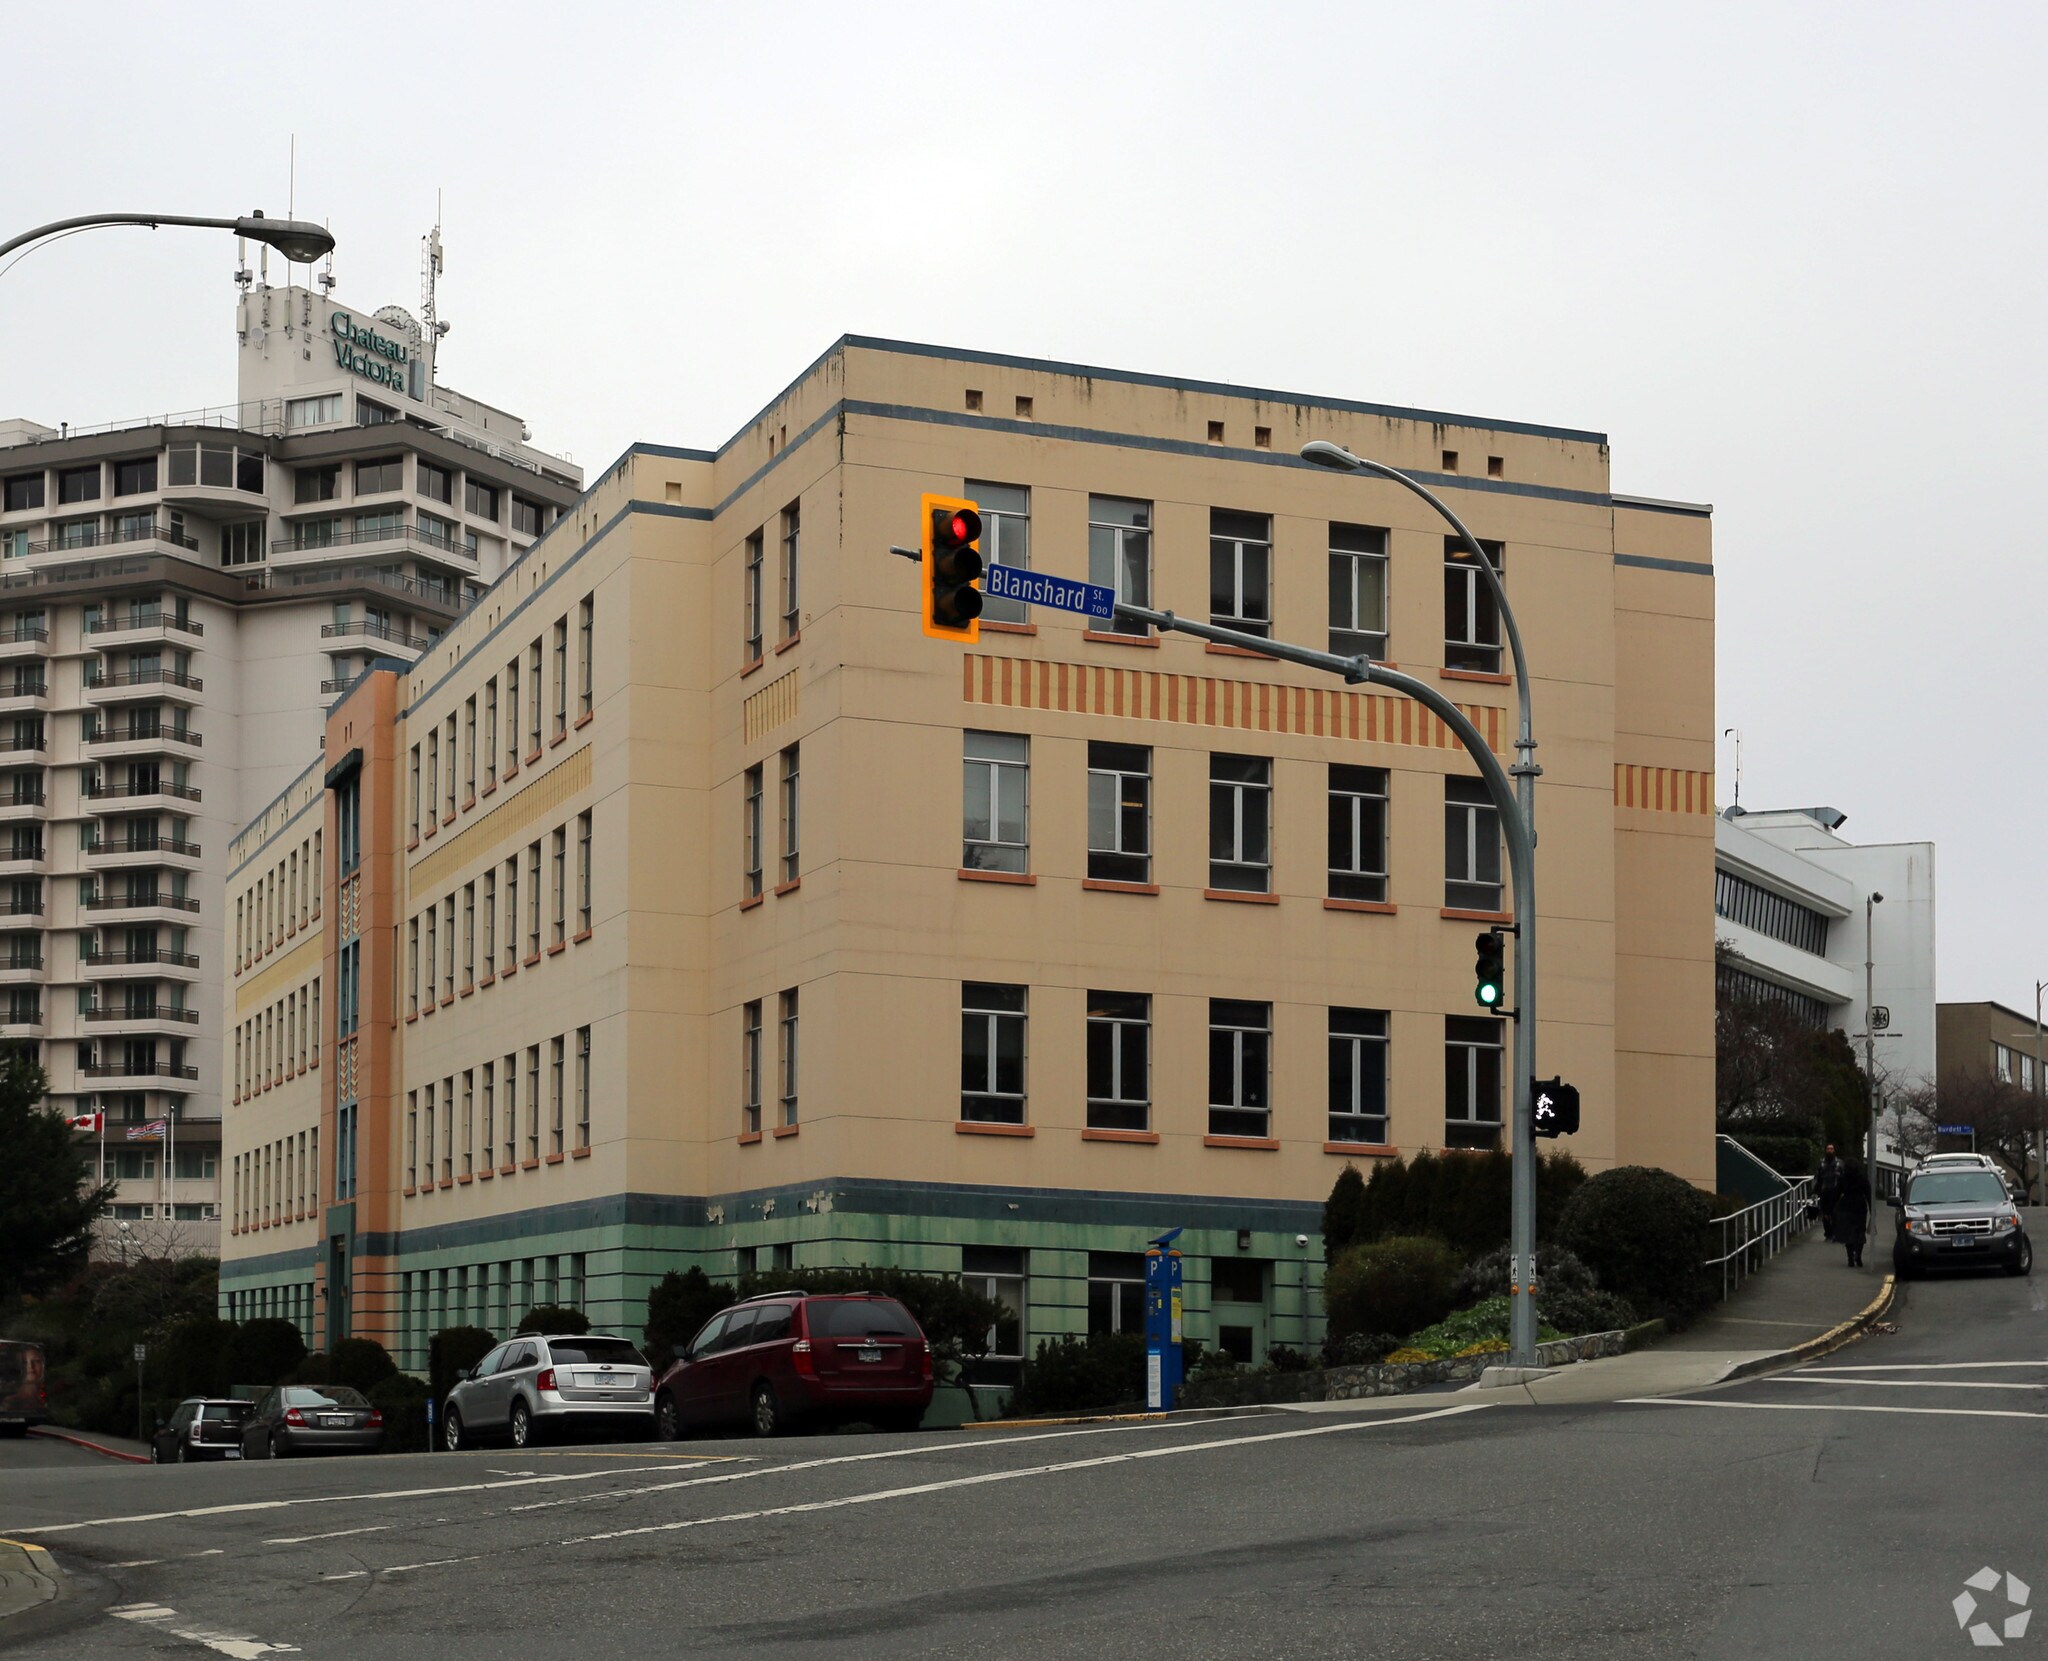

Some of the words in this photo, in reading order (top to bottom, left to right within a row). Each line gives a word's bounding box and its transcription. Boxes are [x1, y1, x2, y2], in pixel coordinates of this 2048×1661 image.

[331, 311, 408, 365] Chateau
[333, 339, 405, 391] Victoria
[991, 569, 1086, 610] Blanshard
[1093, 589, 1105, 601] St.
[1092, 604, 1108, 615] 700
[1150, 1260, 1158, 1276] P
[1171, 1261, 1178, 1276] P
